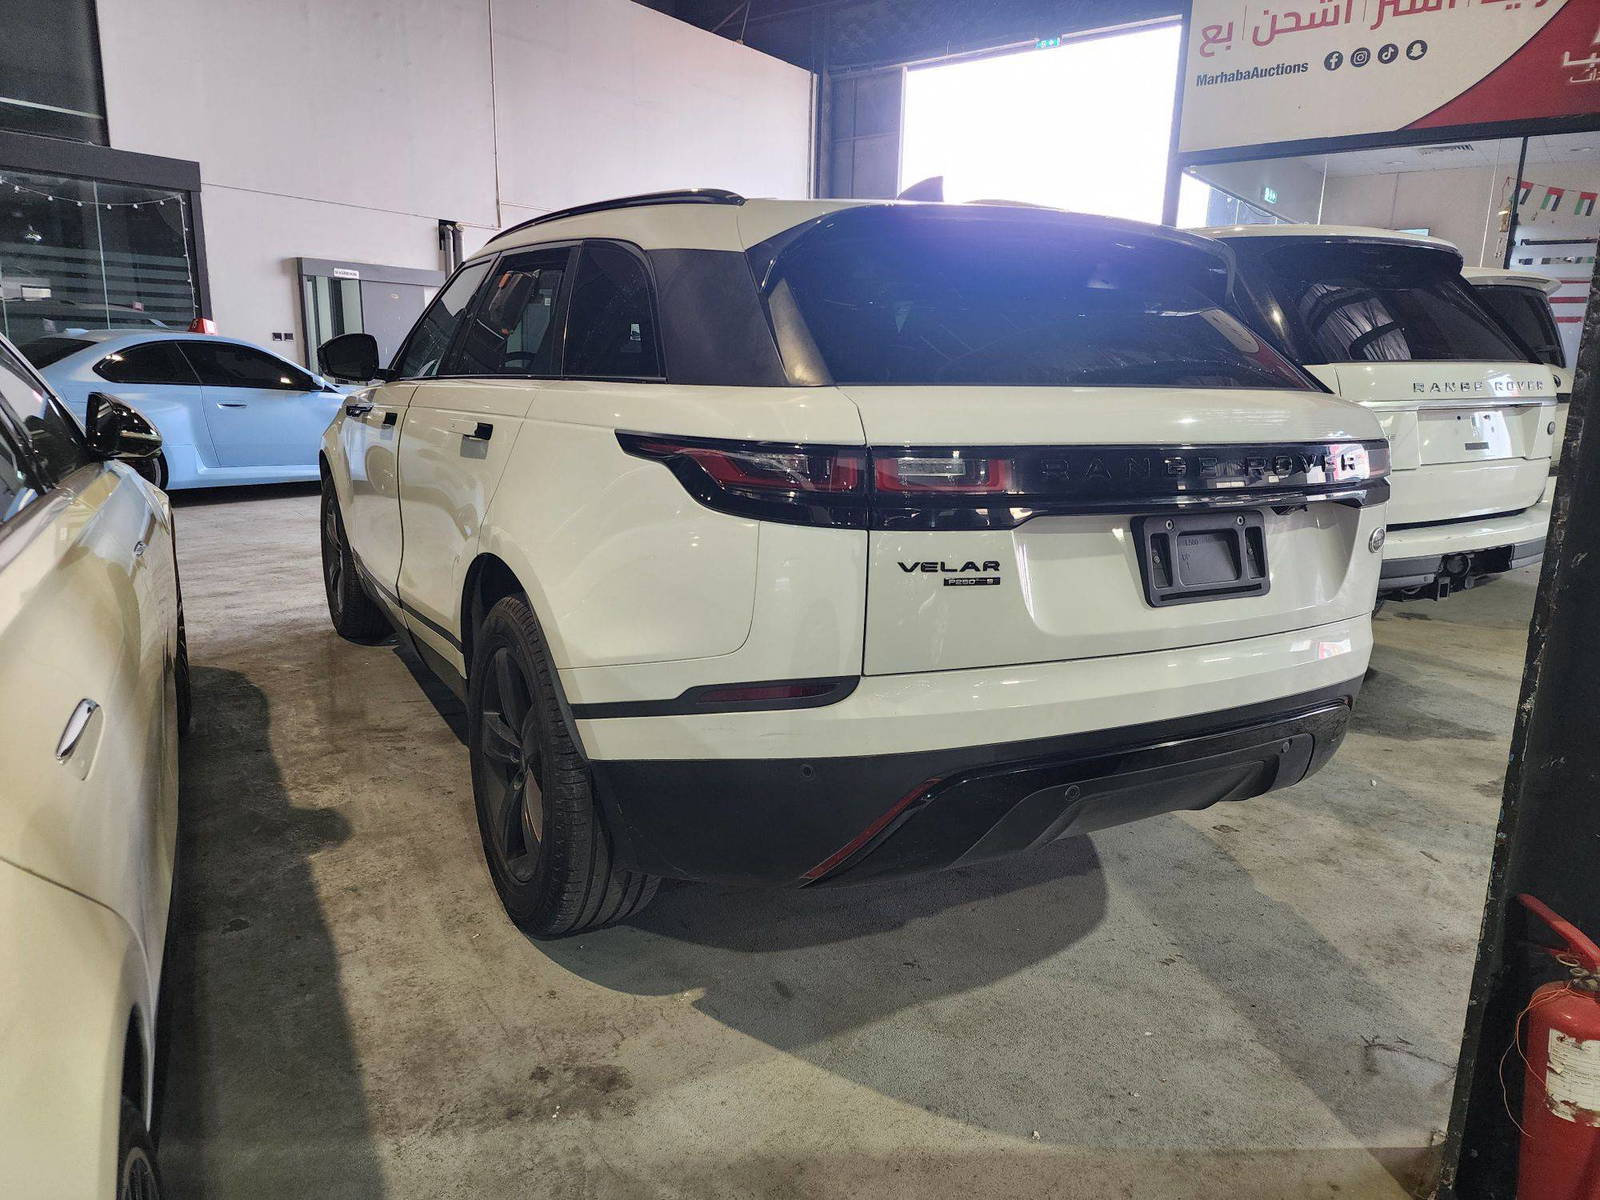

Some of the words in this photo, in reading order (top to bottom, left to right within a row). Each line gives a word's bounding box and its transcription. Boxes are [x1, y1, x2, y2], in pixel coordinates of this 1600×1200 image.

[1199, 21, 1234, 57] بع
[1196, 62, 1309, 87] MarhabaAuctions
[1412, 382, 1483, 393] RANGE
[1494, 380, 1544, 392] ROVER
[1040, 456, 1218, 480] RANGE
[1246, 454, 1356, 478] ROVER
[897, 560, 1001, 573] VELAR
